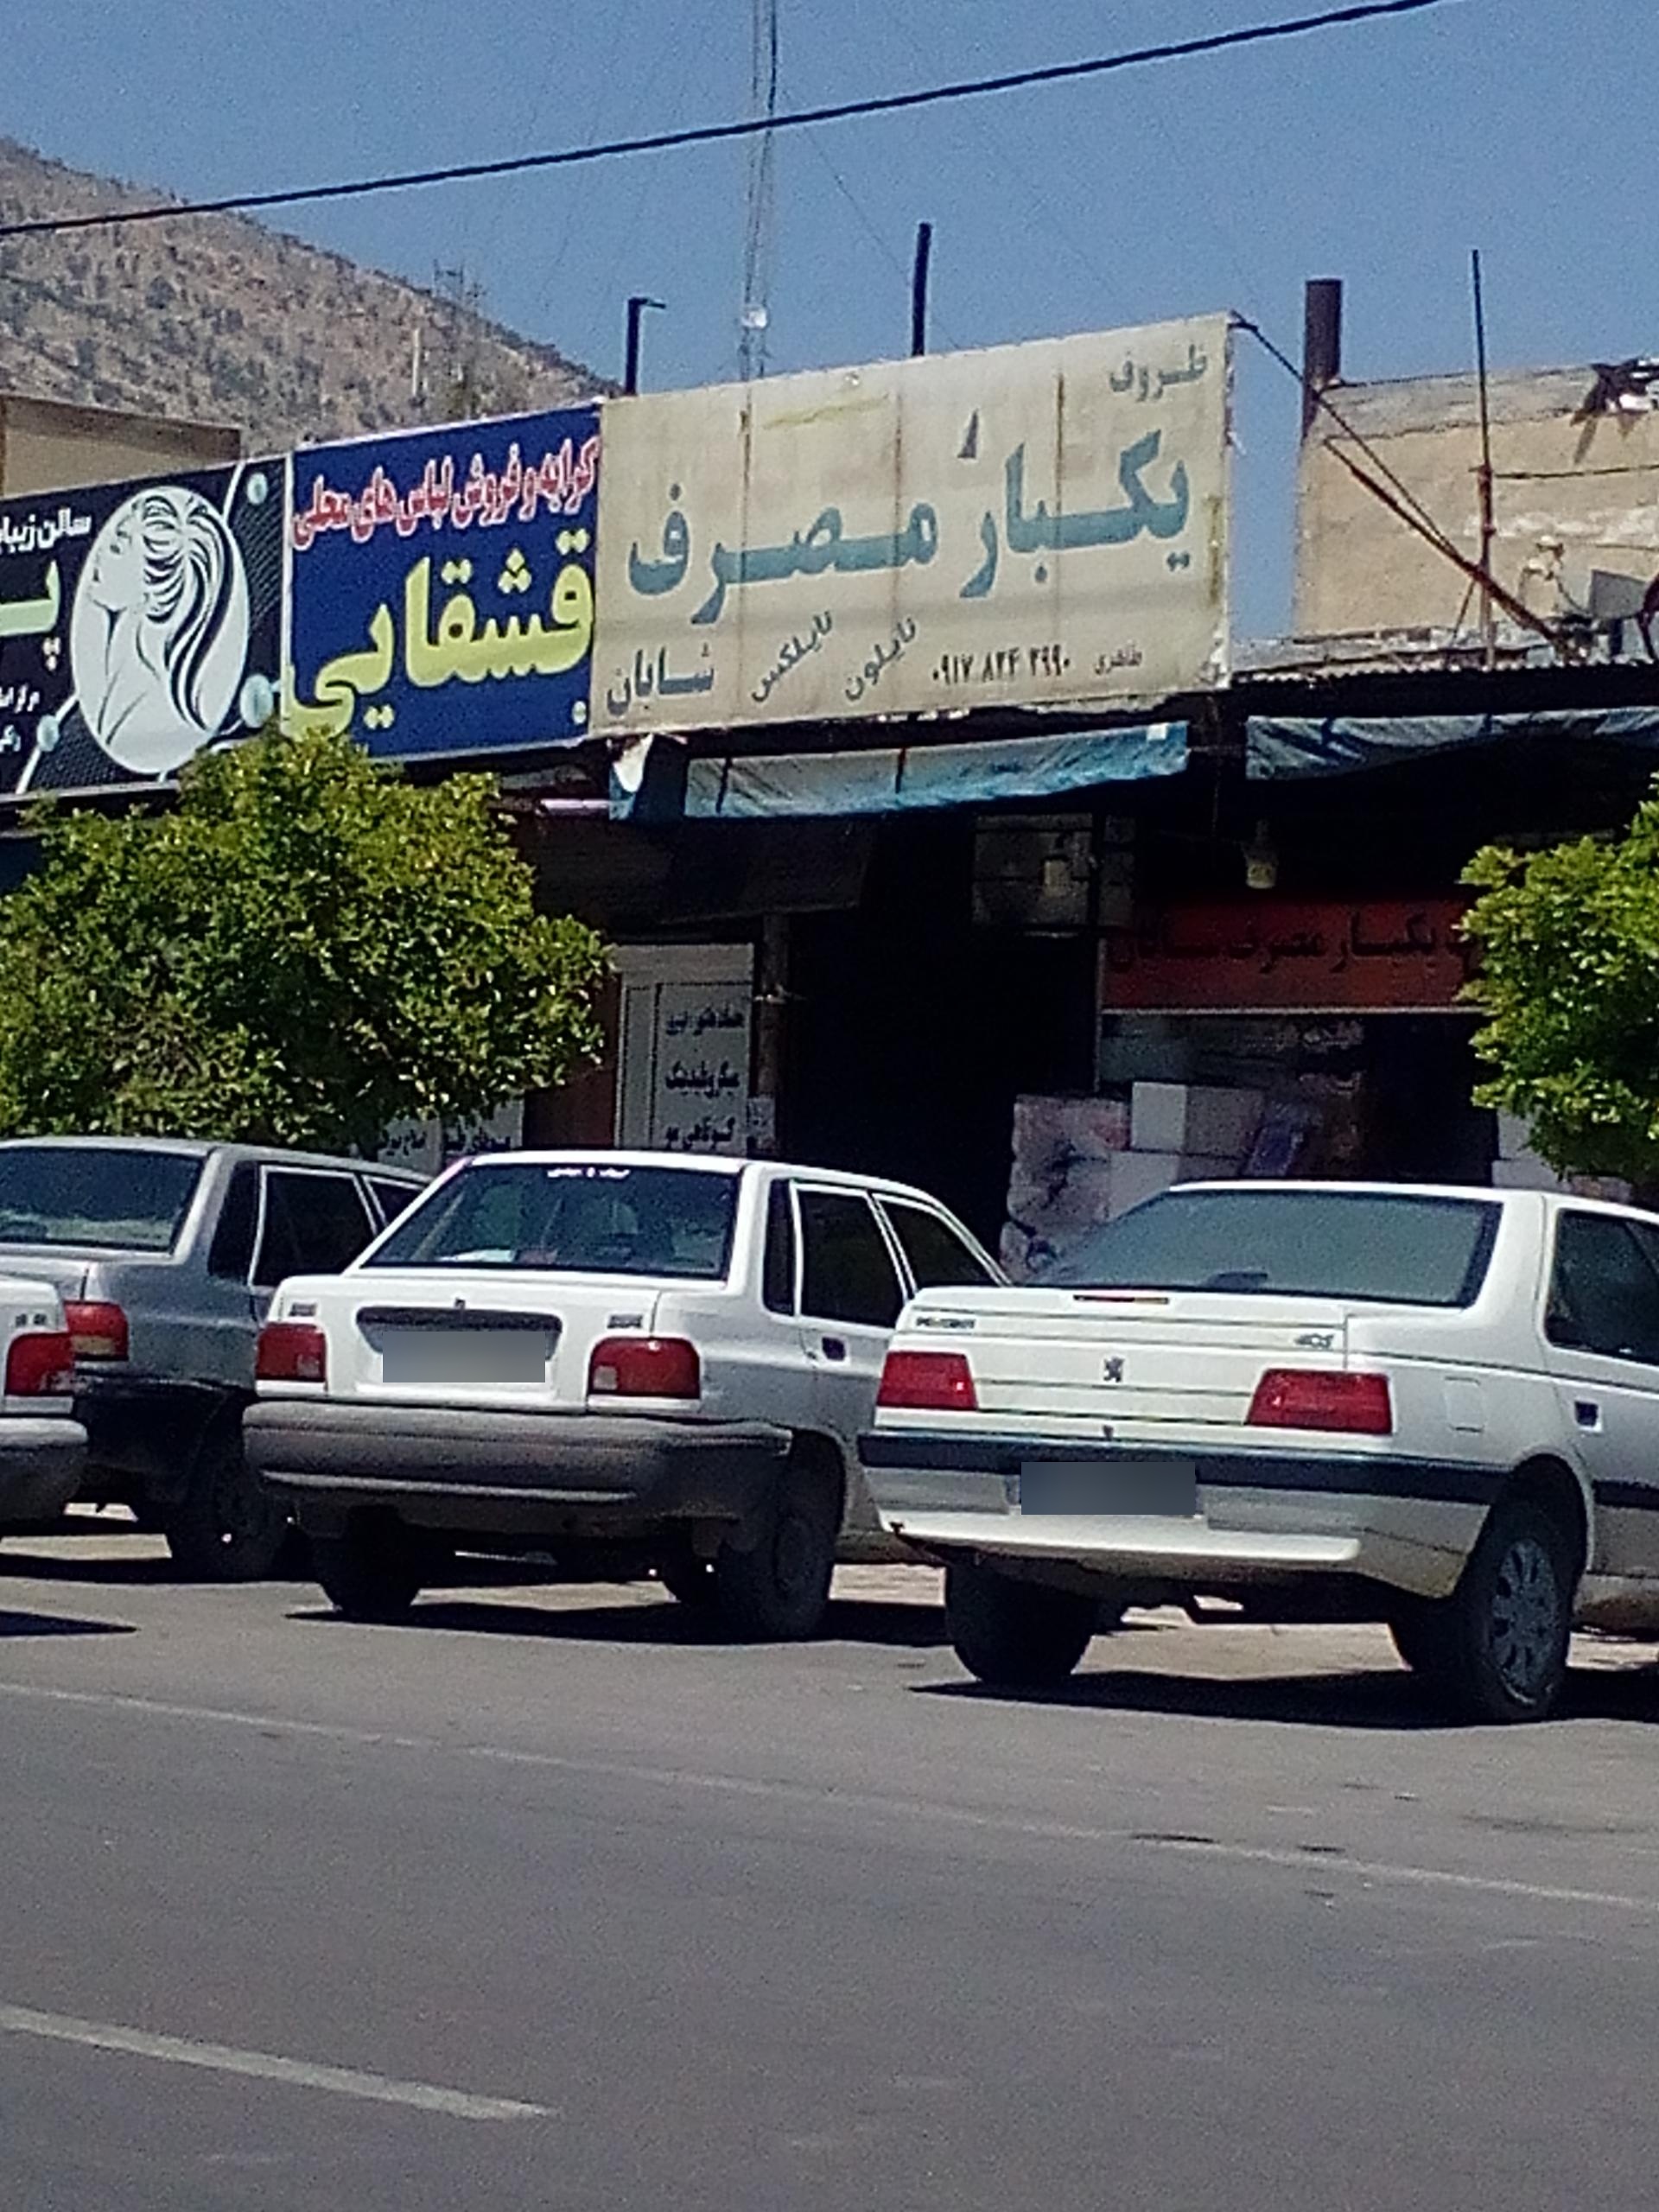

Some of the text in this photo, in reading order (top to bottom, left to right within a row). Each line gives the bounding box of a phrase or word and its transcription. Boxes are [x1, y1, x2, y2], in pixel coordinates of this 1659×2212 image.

[292, 474, 353, 551] محلی
[396, 454, 454, 537] لباس
[450, 442, 521, 530] فروش
[627, 482, 940, 625] مصرف
[281, 528, 595, 743] قشقایی
[844, 617, 917, 702] نایلون
